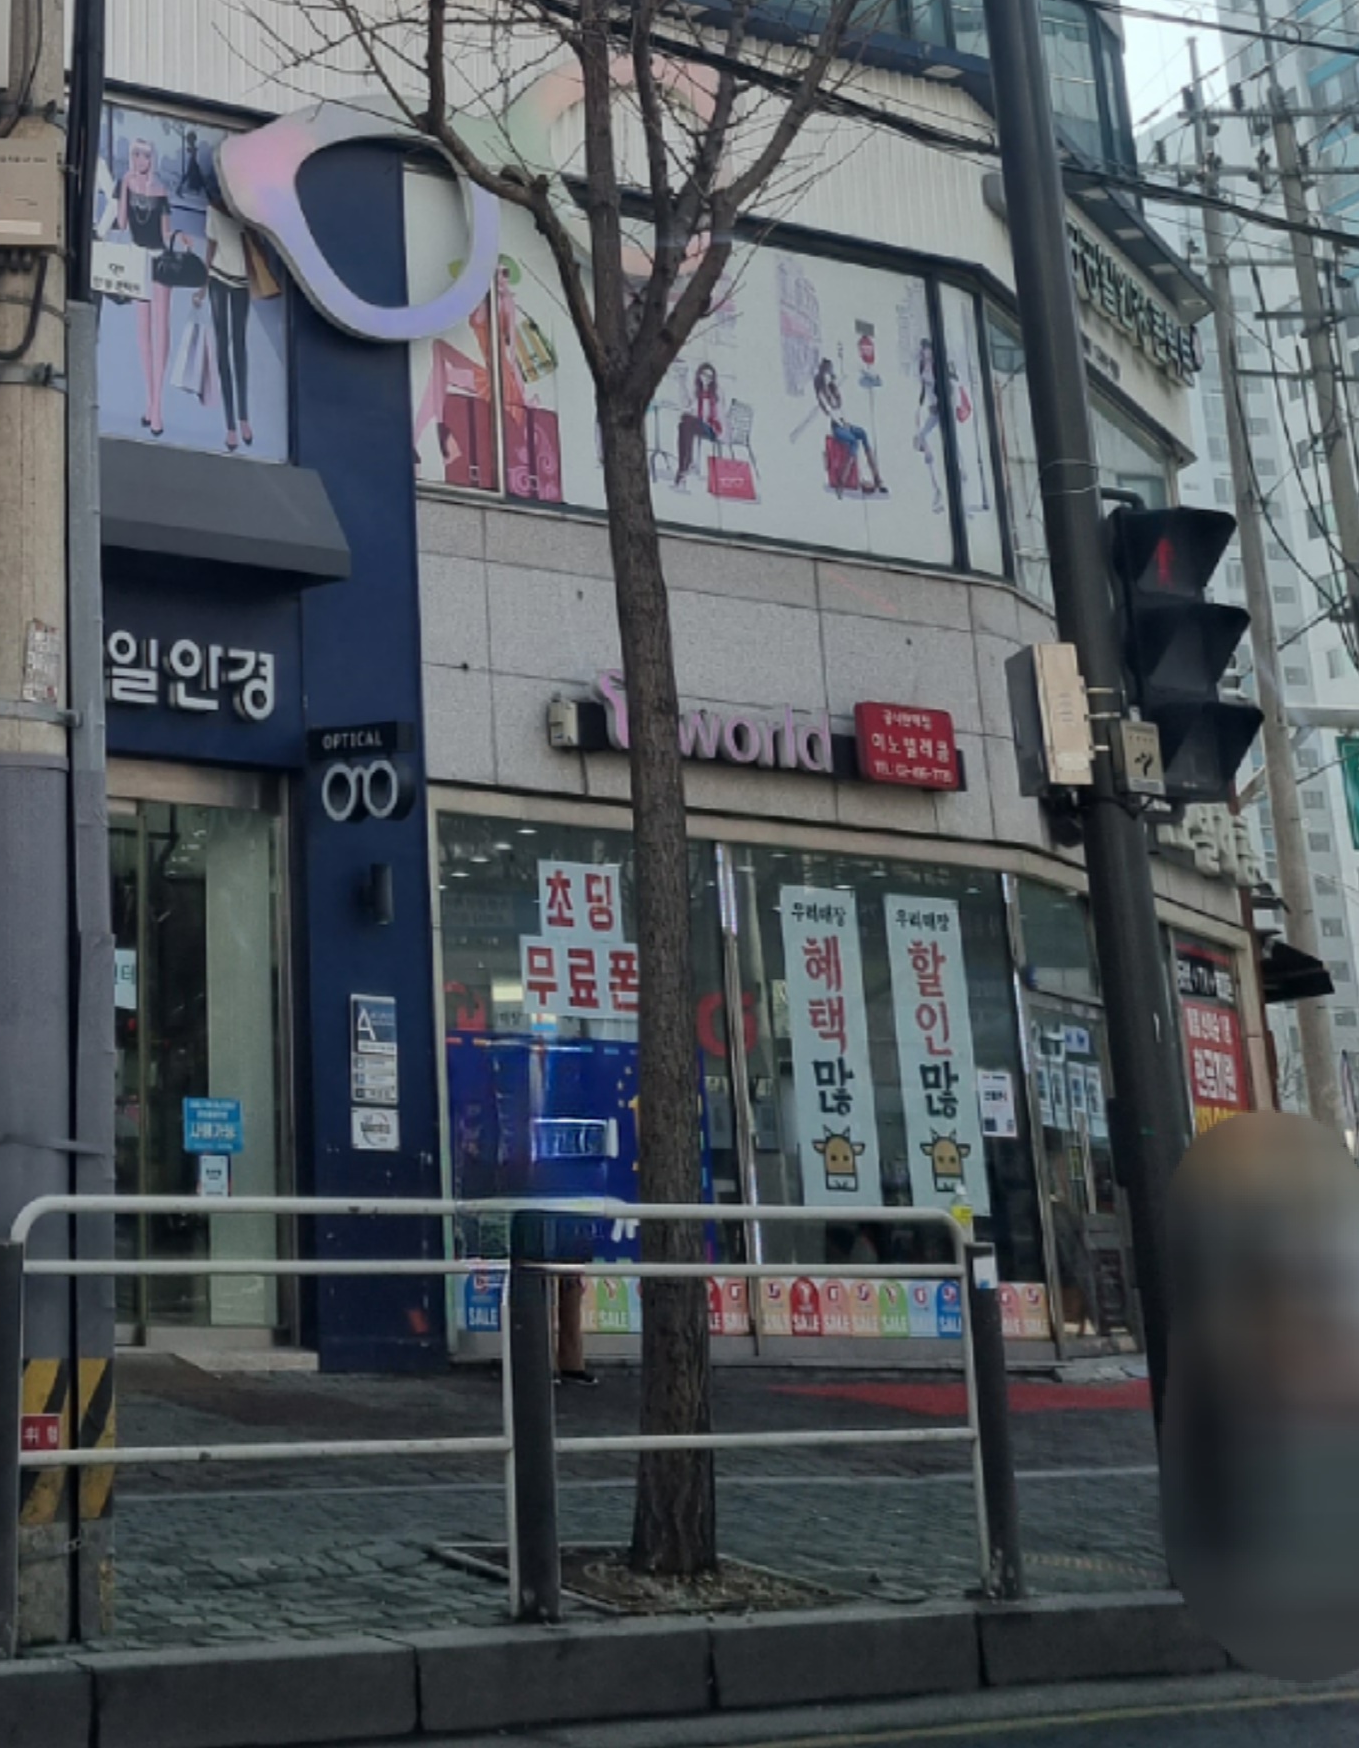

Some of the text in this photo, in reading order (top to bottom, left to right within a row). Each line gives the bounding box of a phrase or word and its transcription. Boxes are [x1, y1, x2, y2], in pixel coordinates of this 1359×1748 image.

[107, 629, 275, 720] 일안경
[321, 730, 383, 750] OPTICAL
[678, 702, 832, 773] world
[545, 868, 615, 932] 초딩
[791, 901, 847, 928] 우리매장
[895, 906, 951, 933] 우리매장
[525, 944, 639, 1012] 무료폰
[802, 936, 855, 1117] 혜택 많
[907, 939, 960, 1120] 할인 많
[468, 1306, 499, 1326] SALE
[599, 1310, 629, 1328] SALE
